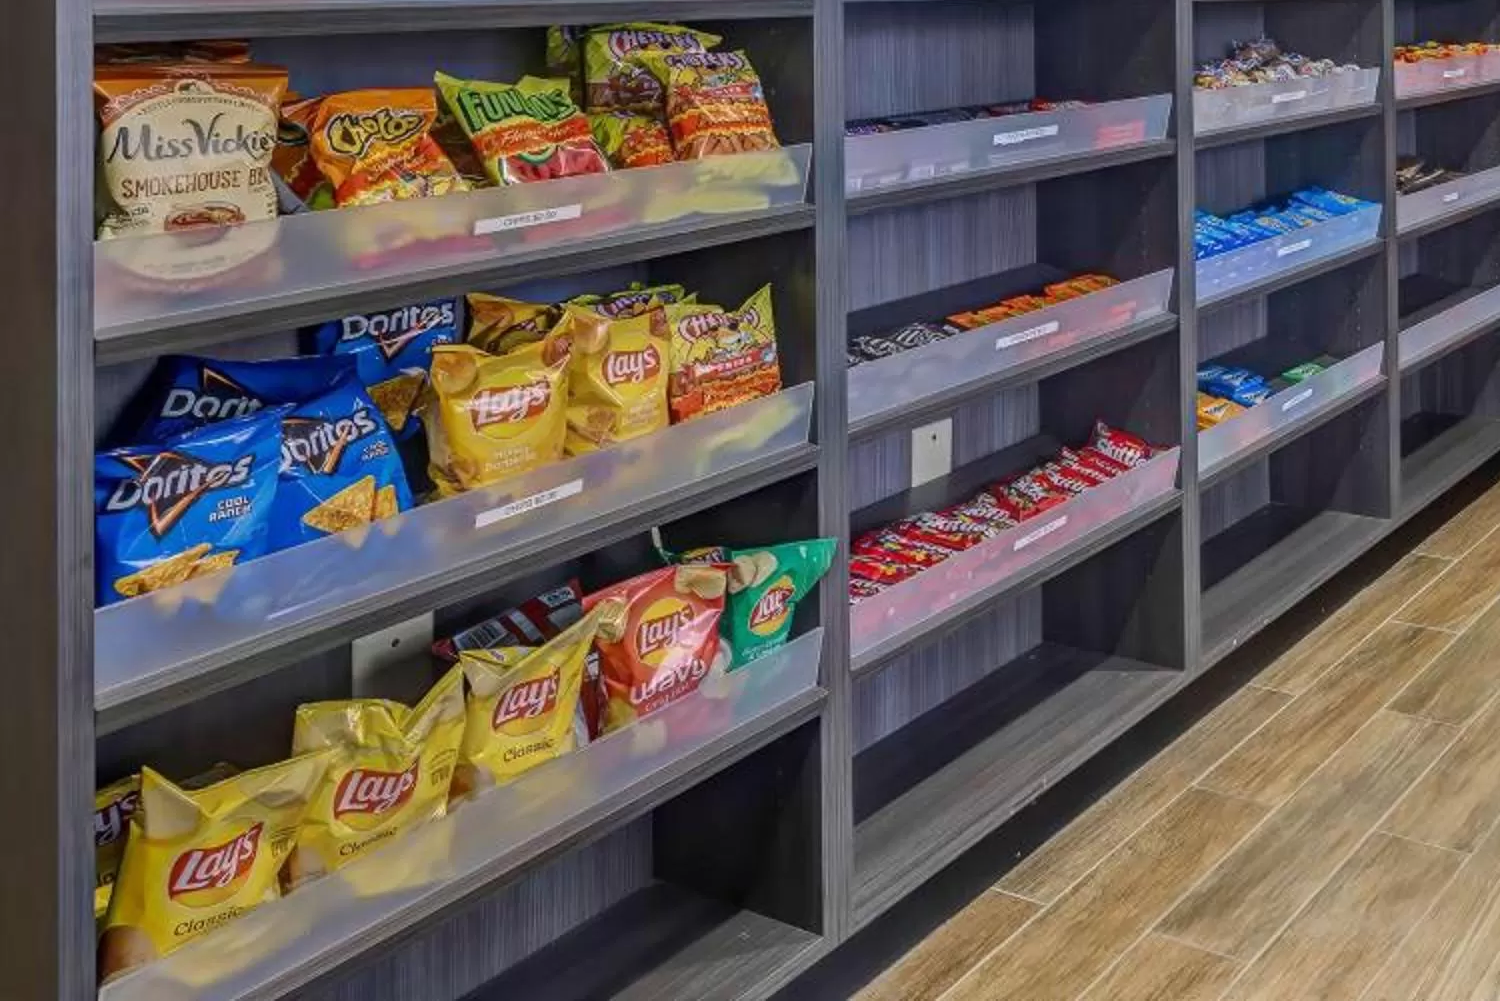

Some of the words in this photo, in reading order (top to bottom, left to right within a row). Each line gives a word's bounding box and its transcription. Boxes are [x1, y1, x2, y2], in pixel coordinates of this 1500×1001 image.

[107, 123, 194, 163] Miss
[121, 170, 241, 199] SMOKEHOUSE
[342, 302, 455, 341] Doritos
[606, 351, 658, 384] Lay's
[160, 388, 263, 420] Dorit
[472, 383, 548, 426] Lay's
[281, 409, 378, 470] Doritos
[107, 455, 254, 512] Doritos
[638, 604, 694, 655] Lay's
[496, 675, 559, 725] Lay's
[504, 739, 554, 763] Classic
[338, 767, 417, 814] Lay's
[173, 830, 261, 891] Lay's
